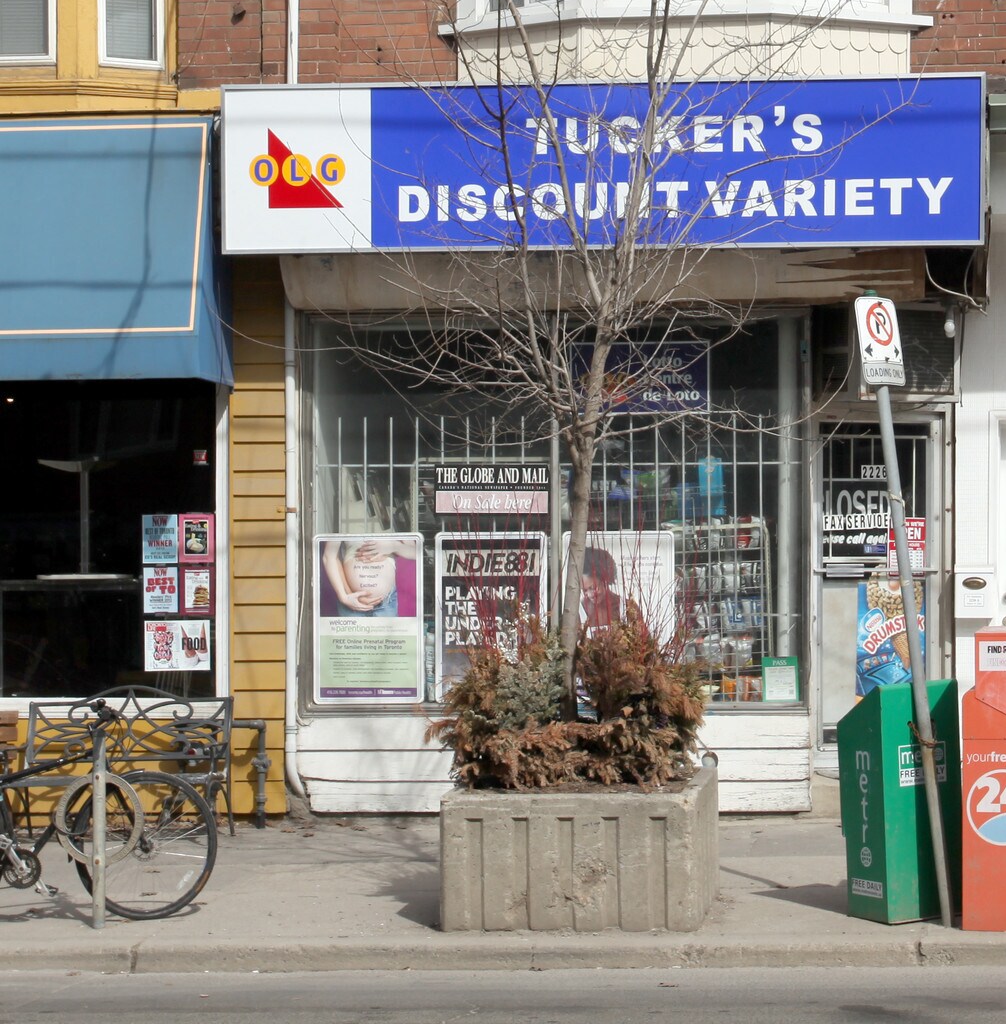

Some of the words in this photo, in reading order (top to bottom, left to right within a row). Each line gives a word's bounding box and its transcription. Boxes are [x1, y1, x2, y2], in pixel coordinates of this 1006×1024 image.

[526, 106, 823, 155] TUCKER'S
[254, 158, 338, 182] OLG
[398, 181, 689, 223] DISCOUNT
[704, 176, 954, 218] VARIETY
[866, 367, 892, 378] LOADING
[892, 369, 903, 379] ONLY
[436, 467, 457, 483] THE
[460, 467, 494, 484] GLOBE
[497, 467, 519, 483] AND
[522, 467, 549, 483] MAIL
[862, 466, 887, 478] 2226
[452, 494, 471, 510] On
[474, 493, 501, 510] Sale
[504, 493, 532, 510] here
[824, 515, 844, 530] FAX
[846, 532, 866, 544] call
[866, 533, 888, 545] agai
[153, 568, 168, 577] NOW
[147, 577, 175, 585] BEST
[160, 585, 176, 594] TO
[445, 601, 477, 615] THE
[335, 625, 371, 633] parenting
[863, 614, 924, 653] DRUMSTK
[182, 637, 207, 650] FOOD
[987, 645, 1002, 653] FIND
[901, 768, 920, 779] FREE
